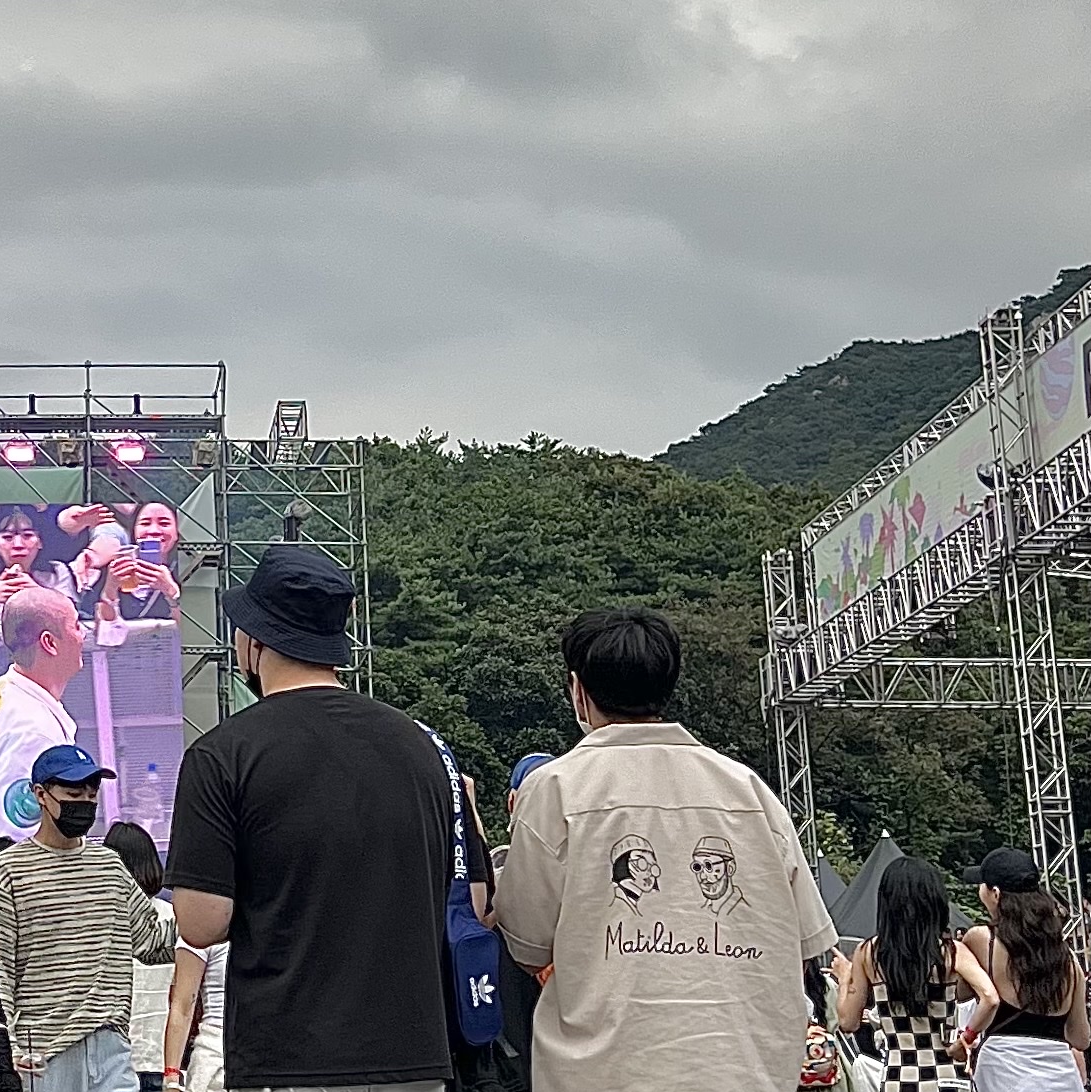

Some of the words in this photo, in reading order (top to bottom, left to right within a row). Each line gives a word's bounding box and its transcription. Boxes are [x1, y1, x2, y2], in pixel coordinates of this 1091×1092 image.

[442, 754, 462, 813] adidas
[605, 921, 694, 960] Matilda
[697, 936, 709, 954] &
[715, 922, 763, 959] Leon
